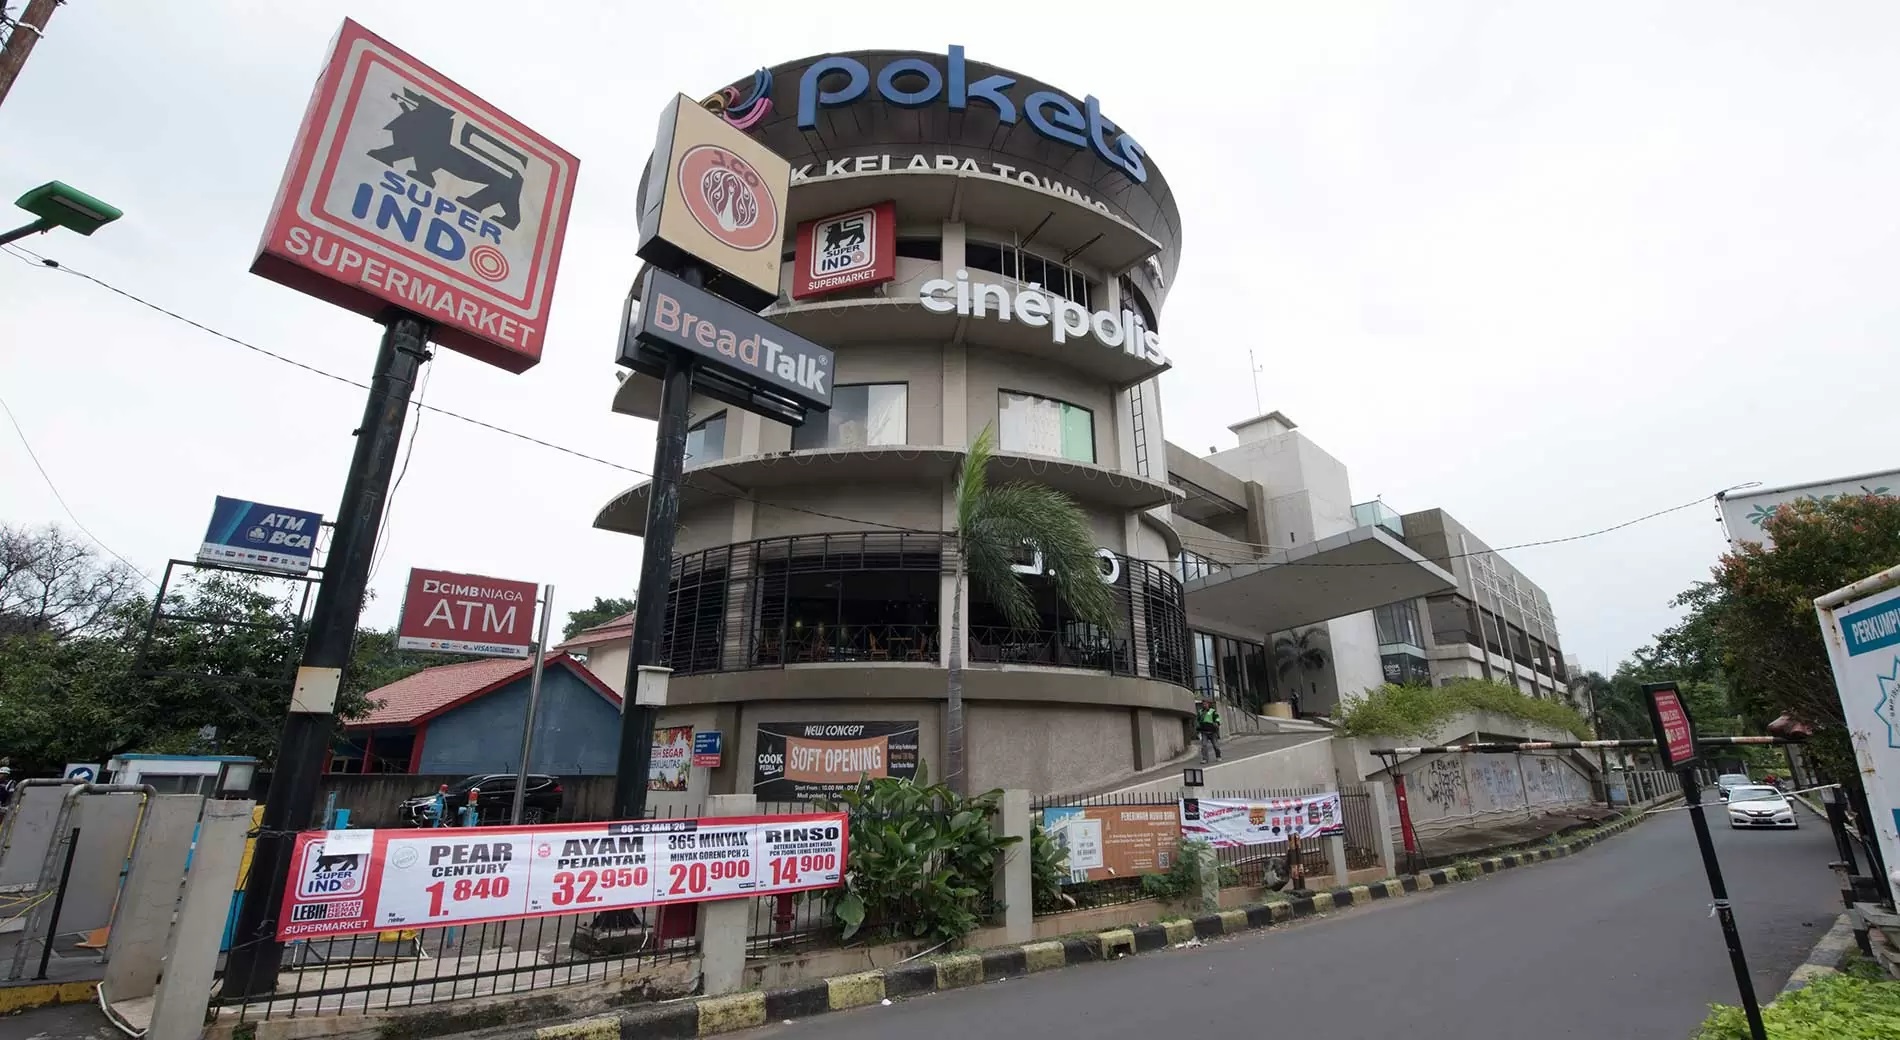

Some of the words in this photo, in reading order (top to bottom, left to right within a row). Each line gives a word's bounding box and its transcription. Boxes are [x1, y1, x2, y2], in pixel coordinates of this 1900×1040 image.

[797, 44, 1147, 185] pokets
[379, 170, 502, 245] SUPER
[826, 244, 861, 258] SUPER
[285, 226, 536, 348] SUPERMARKET
[808, 269, 876, 290] SUPERMARKET
[919, 269, 1167, 366] cinépolis
[260, 512, 307, 531] ATM
[268, 530, 312, 549] BCA
[423, 598, 517, 635] ATM
[804, 726, 824, 736] NEW
[825, 725, 865, 736] CONCEPT
[662, 748, 684, 758] SEGAR
[758, 753, 783, 764] COOK
[791, 745, 822, 772] SOFT
[824, 744, 882, 773] OPENING
[640, 824, 650, 833] 12
[651, 823, 671, 832] MAR
[765, 827, 839, 843] RINSO
[561, 836, 644, 857] AYAM
[667, 834, 696, 850] 365
[699, 831, 749, 848] MINYAK
[429, 842, 512, 866] PEAR
[557, 854, 646, 870] PEJANTAN
[670, 851, 698, 862] MINYAK
[699, 850, 726, 861] GORENG
[726, 849, 741, 858] PCH
[315, 871, 352, 880] SUPER
[431, 862, 508, 878] CENTURY
[292, 903, 329, 921] LEBIH
[326, 911, 359, 919] DEKAT
[328, 906, 361, 914] HEMAT
[284, 919, 369, 935] SUPERMARKET
